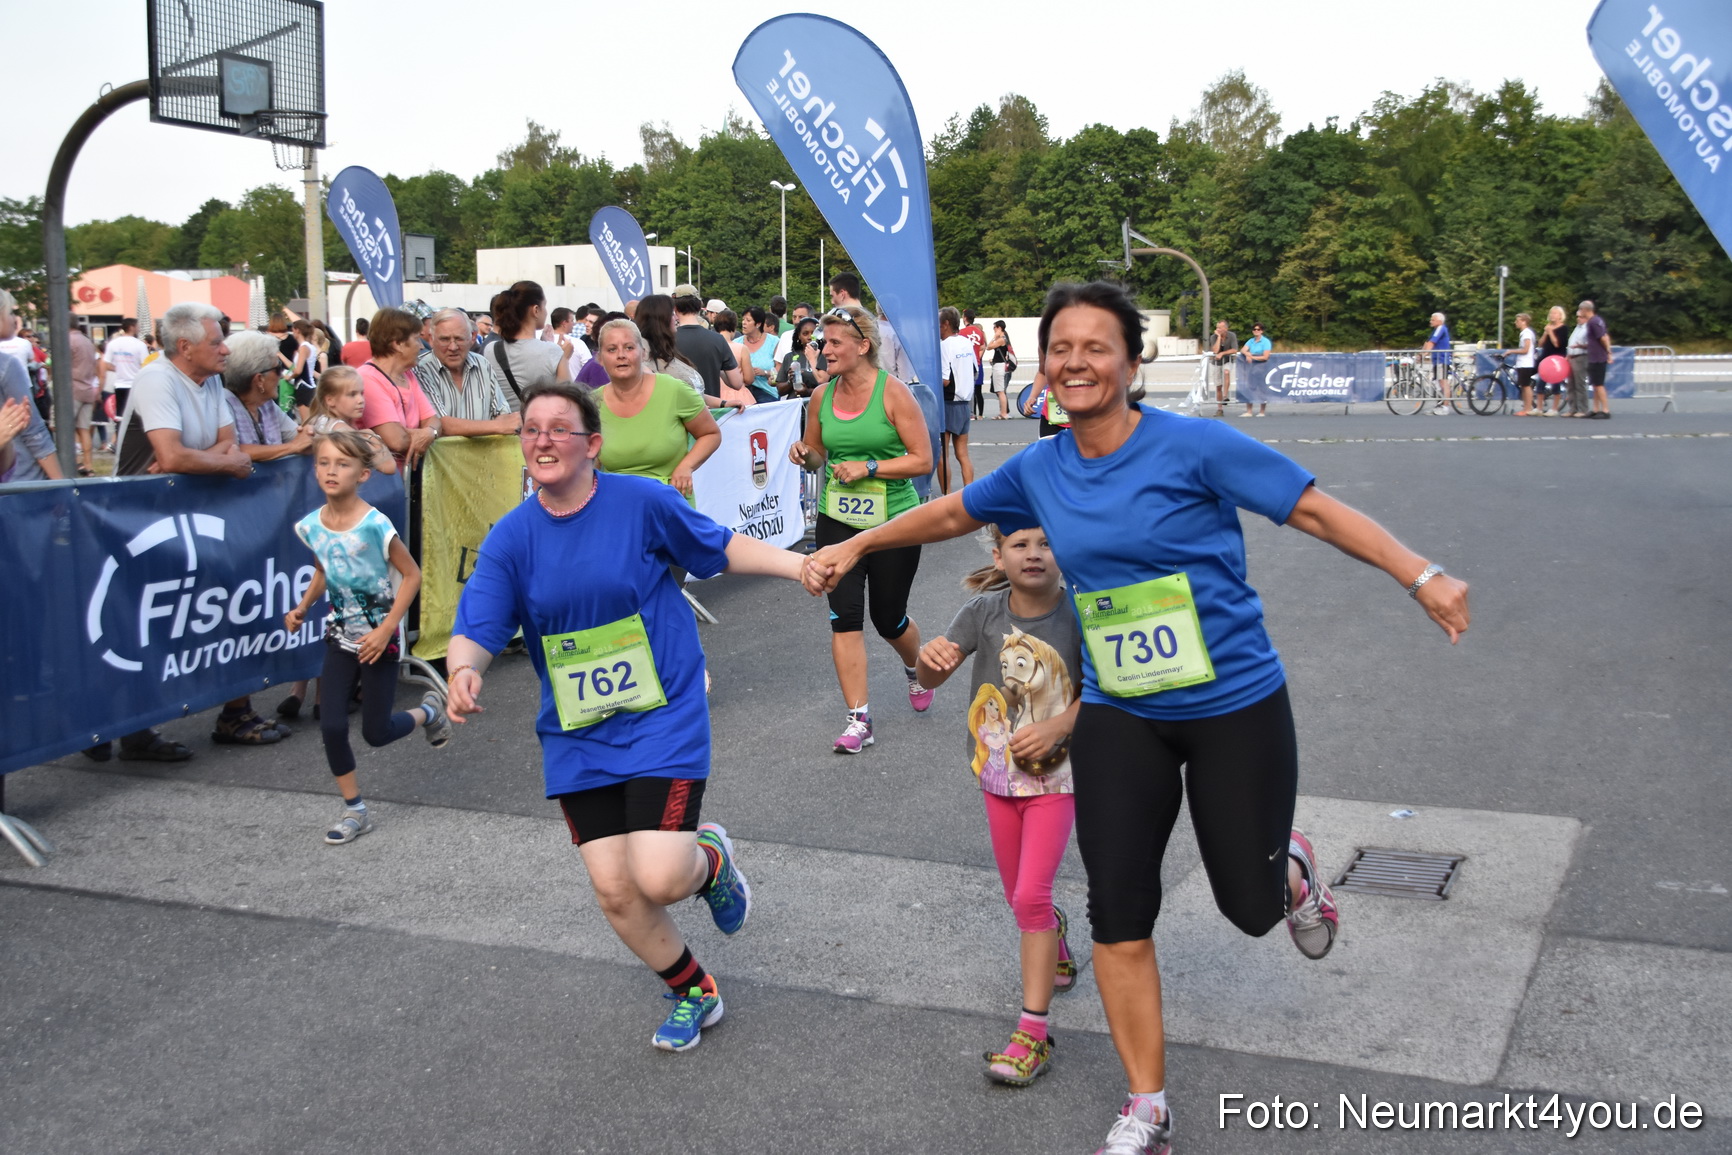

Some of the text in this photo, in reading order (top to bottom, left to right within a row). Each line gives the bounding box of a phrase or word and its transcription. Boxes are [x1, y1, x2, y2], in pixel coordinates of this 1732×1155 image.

[78, 286, 115, 303] G6
[1280, 373, 1355, 389] Fischer
[1287, 388, 1349, 397] AUTOMOBILE
[838, 496, 875, 516] 522
[1104, 624, 1178, 668] 730
[568, 660, 638, 701] 762
[1117, 673, 1141, 682] Carolin
[1141, 665, 1184, 679] Lindenmayr
[579, 694, 642, 714] Jeanette Hafermann
